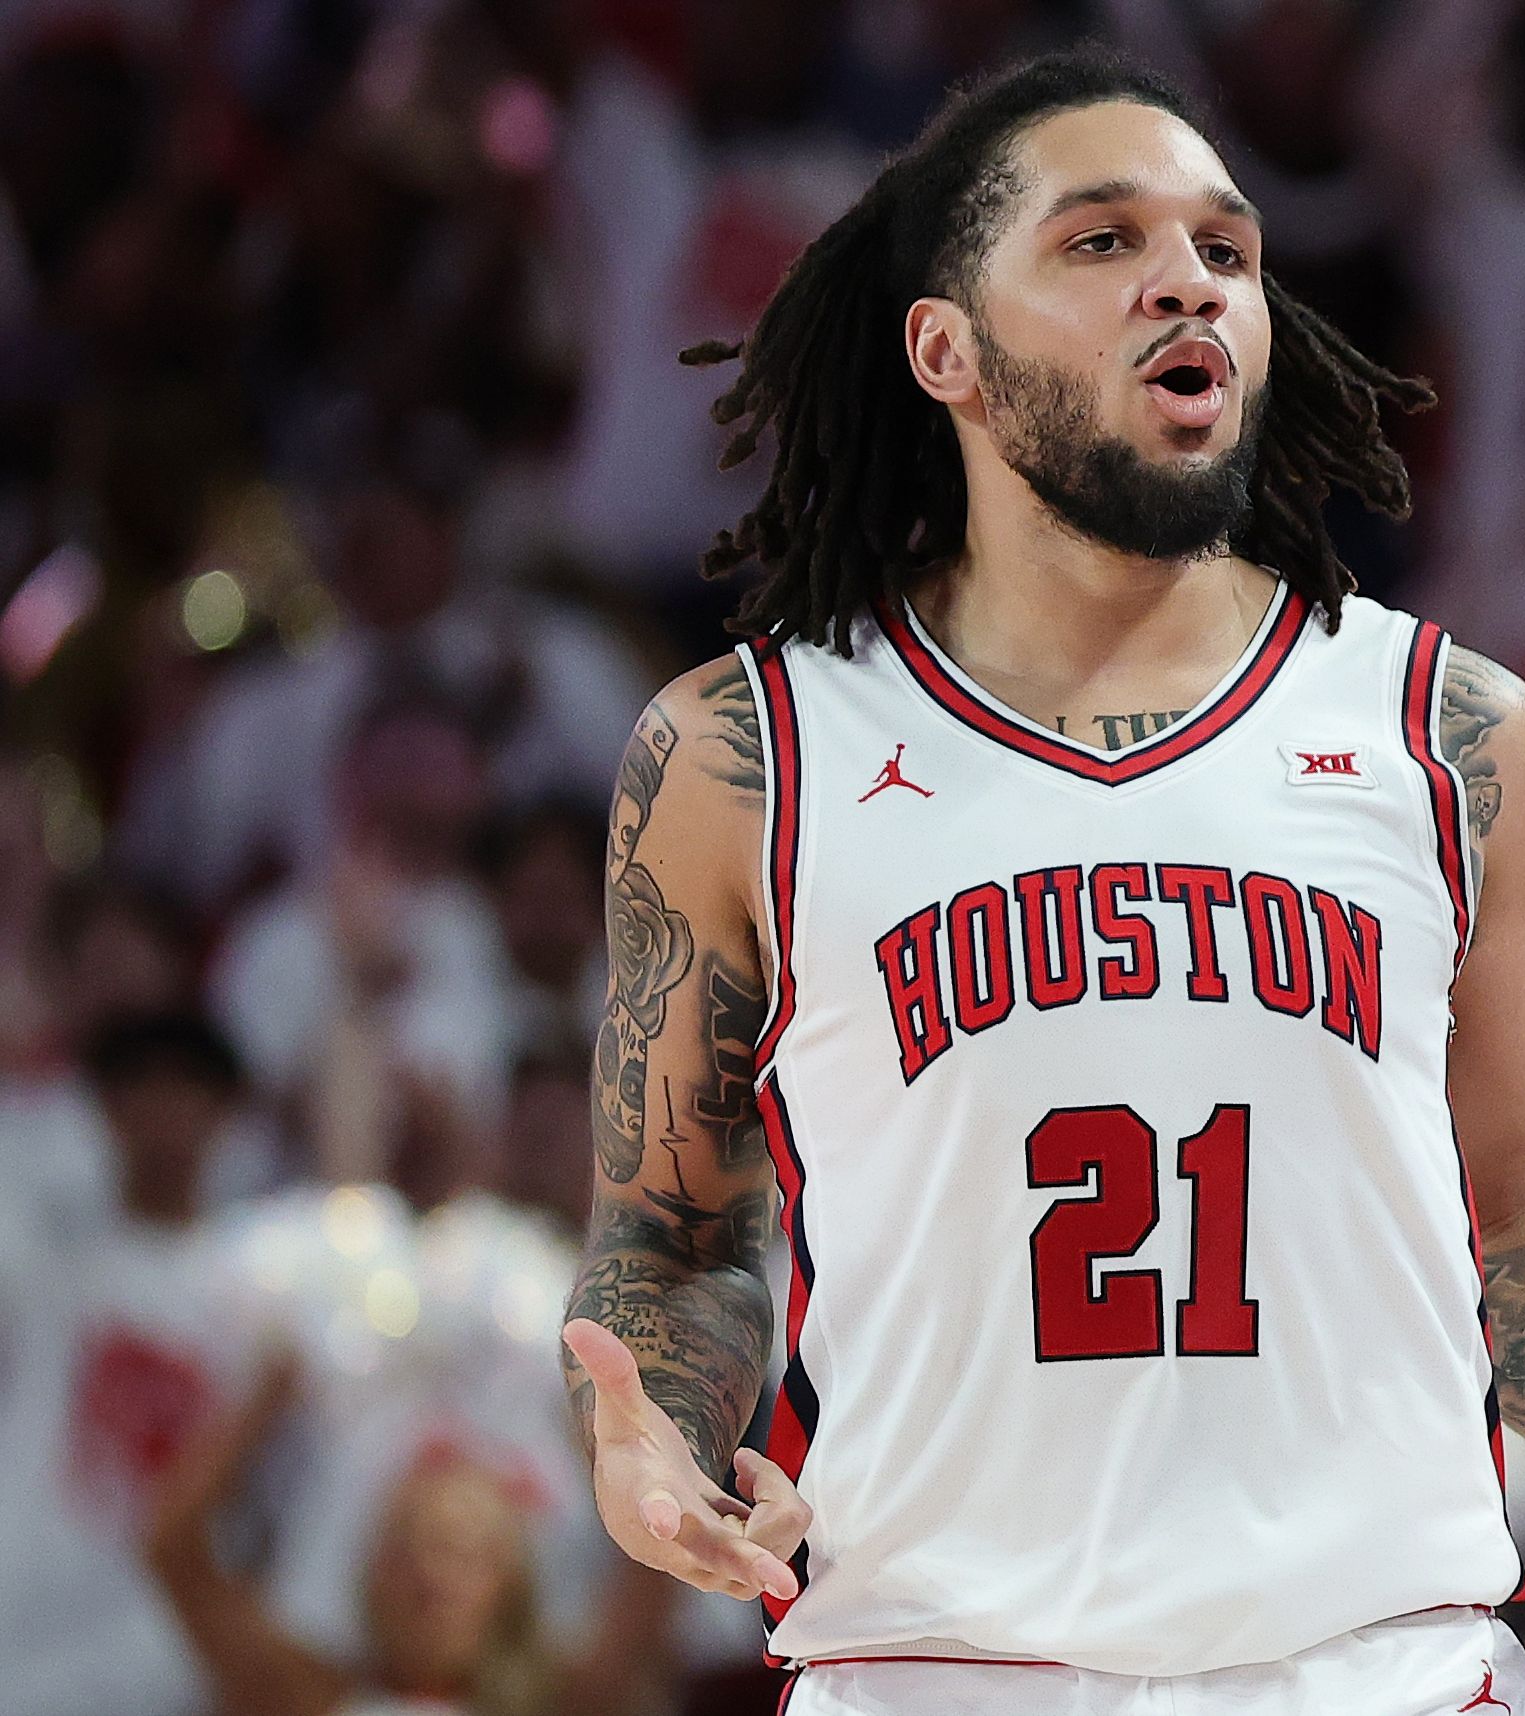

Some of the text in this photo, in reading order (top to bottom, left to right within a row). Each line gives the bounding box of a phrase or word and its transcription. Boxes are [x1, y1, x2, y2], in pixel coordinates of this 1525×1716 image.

[1295, 751, 1362, 776] XII
[873, 861, 1383, 1087] HOUSTON
[1024, 1102, 1260, 1364] 21
